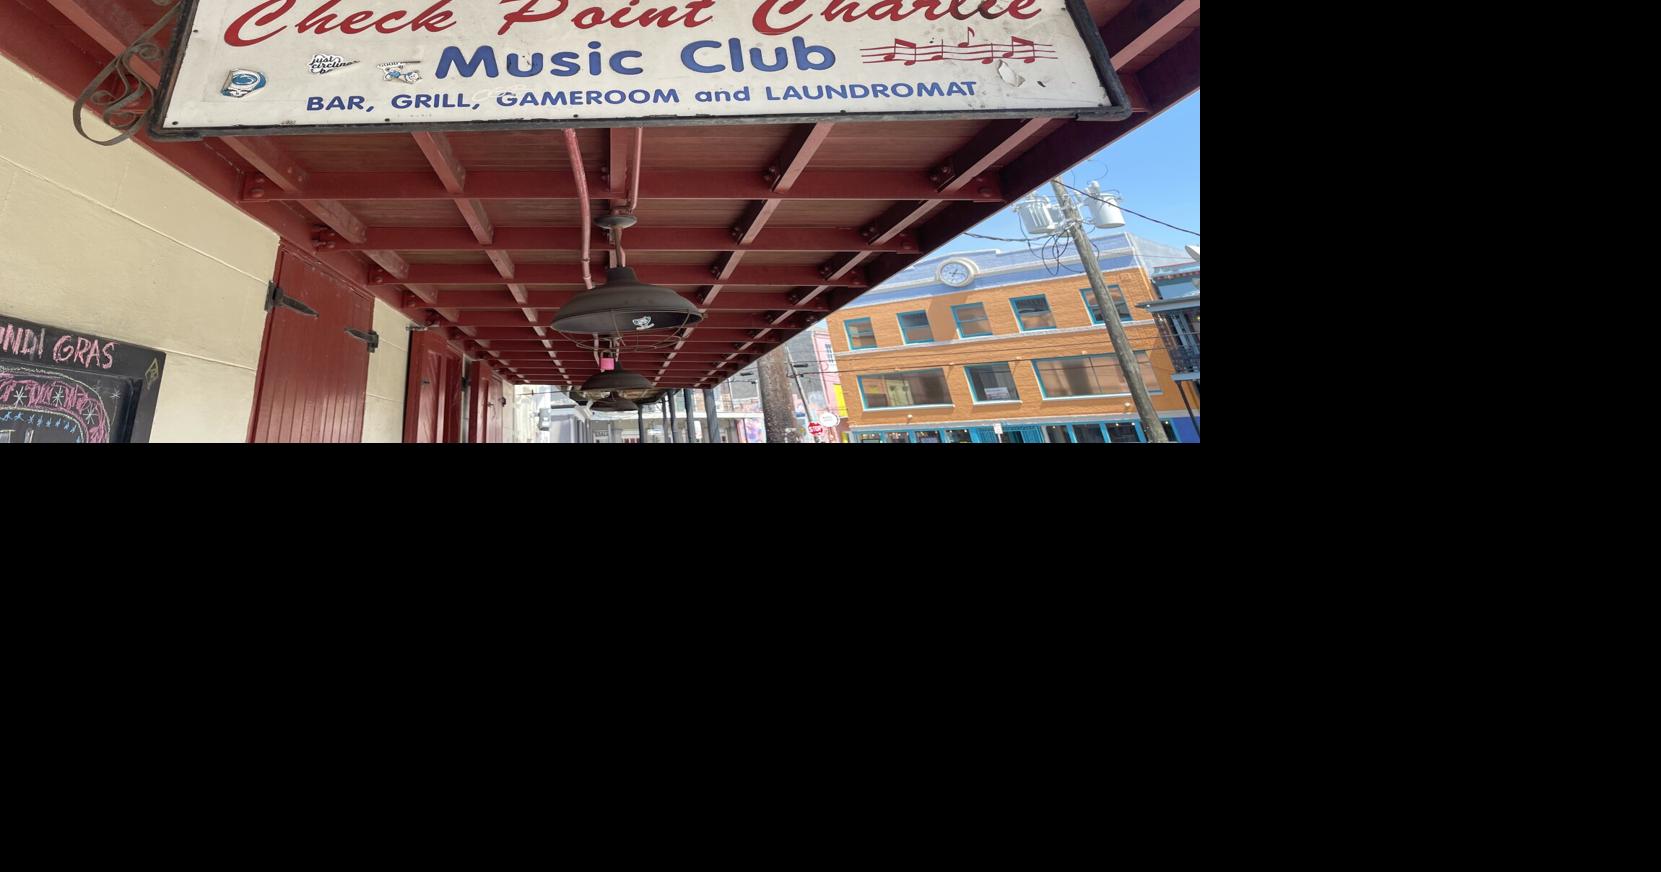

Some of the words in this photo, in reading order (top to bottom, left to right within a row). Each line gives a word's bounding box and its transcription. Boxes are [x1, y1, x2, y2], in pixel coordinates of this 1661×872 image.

[224, 0, 457, 46] Check
[497, 0, 716, 36] Point
[752, 0, 1042, 36] Charlie
[435, 41, 643, 79] Music
[680, 36, 836, 73] Club
[306, 95, 374, 113] BAR,
[391, 91, 480, 110] GRILL,
[496, 88, 679, 106] GAMEROOM
[695, 87, 750, 103] and
[765, 81, 977, 101] LAUNDROMAT
[0, 324, 45, 359] NDI
[53, 335, 116, 369] GRAS
